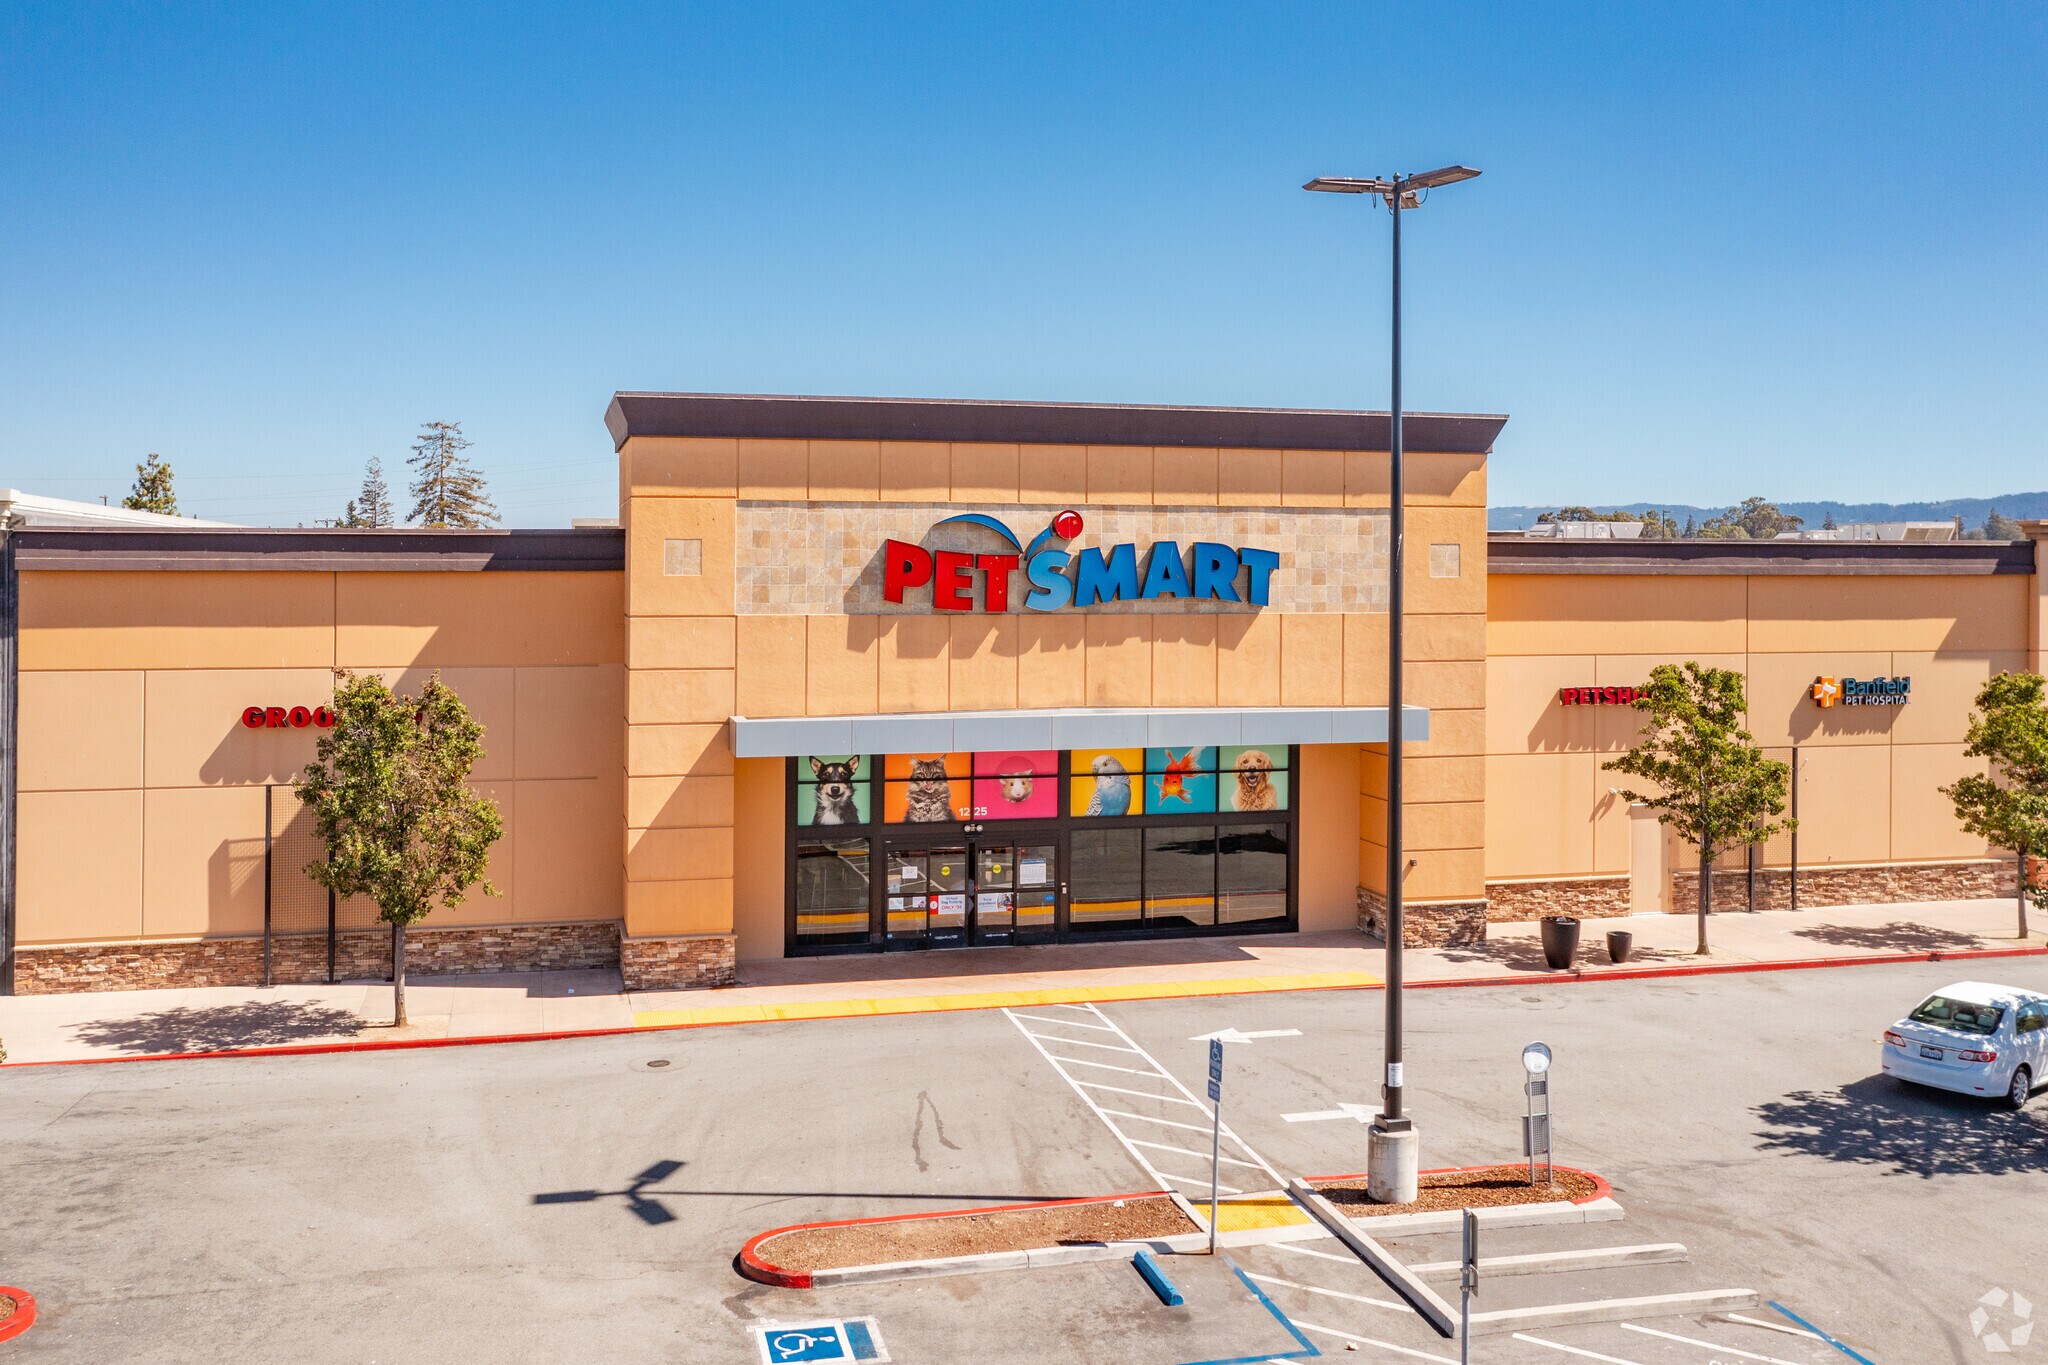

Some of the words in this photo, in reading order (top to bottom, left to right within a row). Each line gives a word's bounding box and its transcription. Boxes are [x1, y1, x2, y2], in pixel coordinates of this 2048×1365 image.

[884, 537, 1280, 612] PETSMART
[1561, 686, 1649, 706] PETSHO
[1844, 677, 1911, 695] Banfield
[1845, 696, 1863, 705] PET
[1866, 695, 1911, 705] HOSPITAL
[242, 706, 336, 728] GROO
